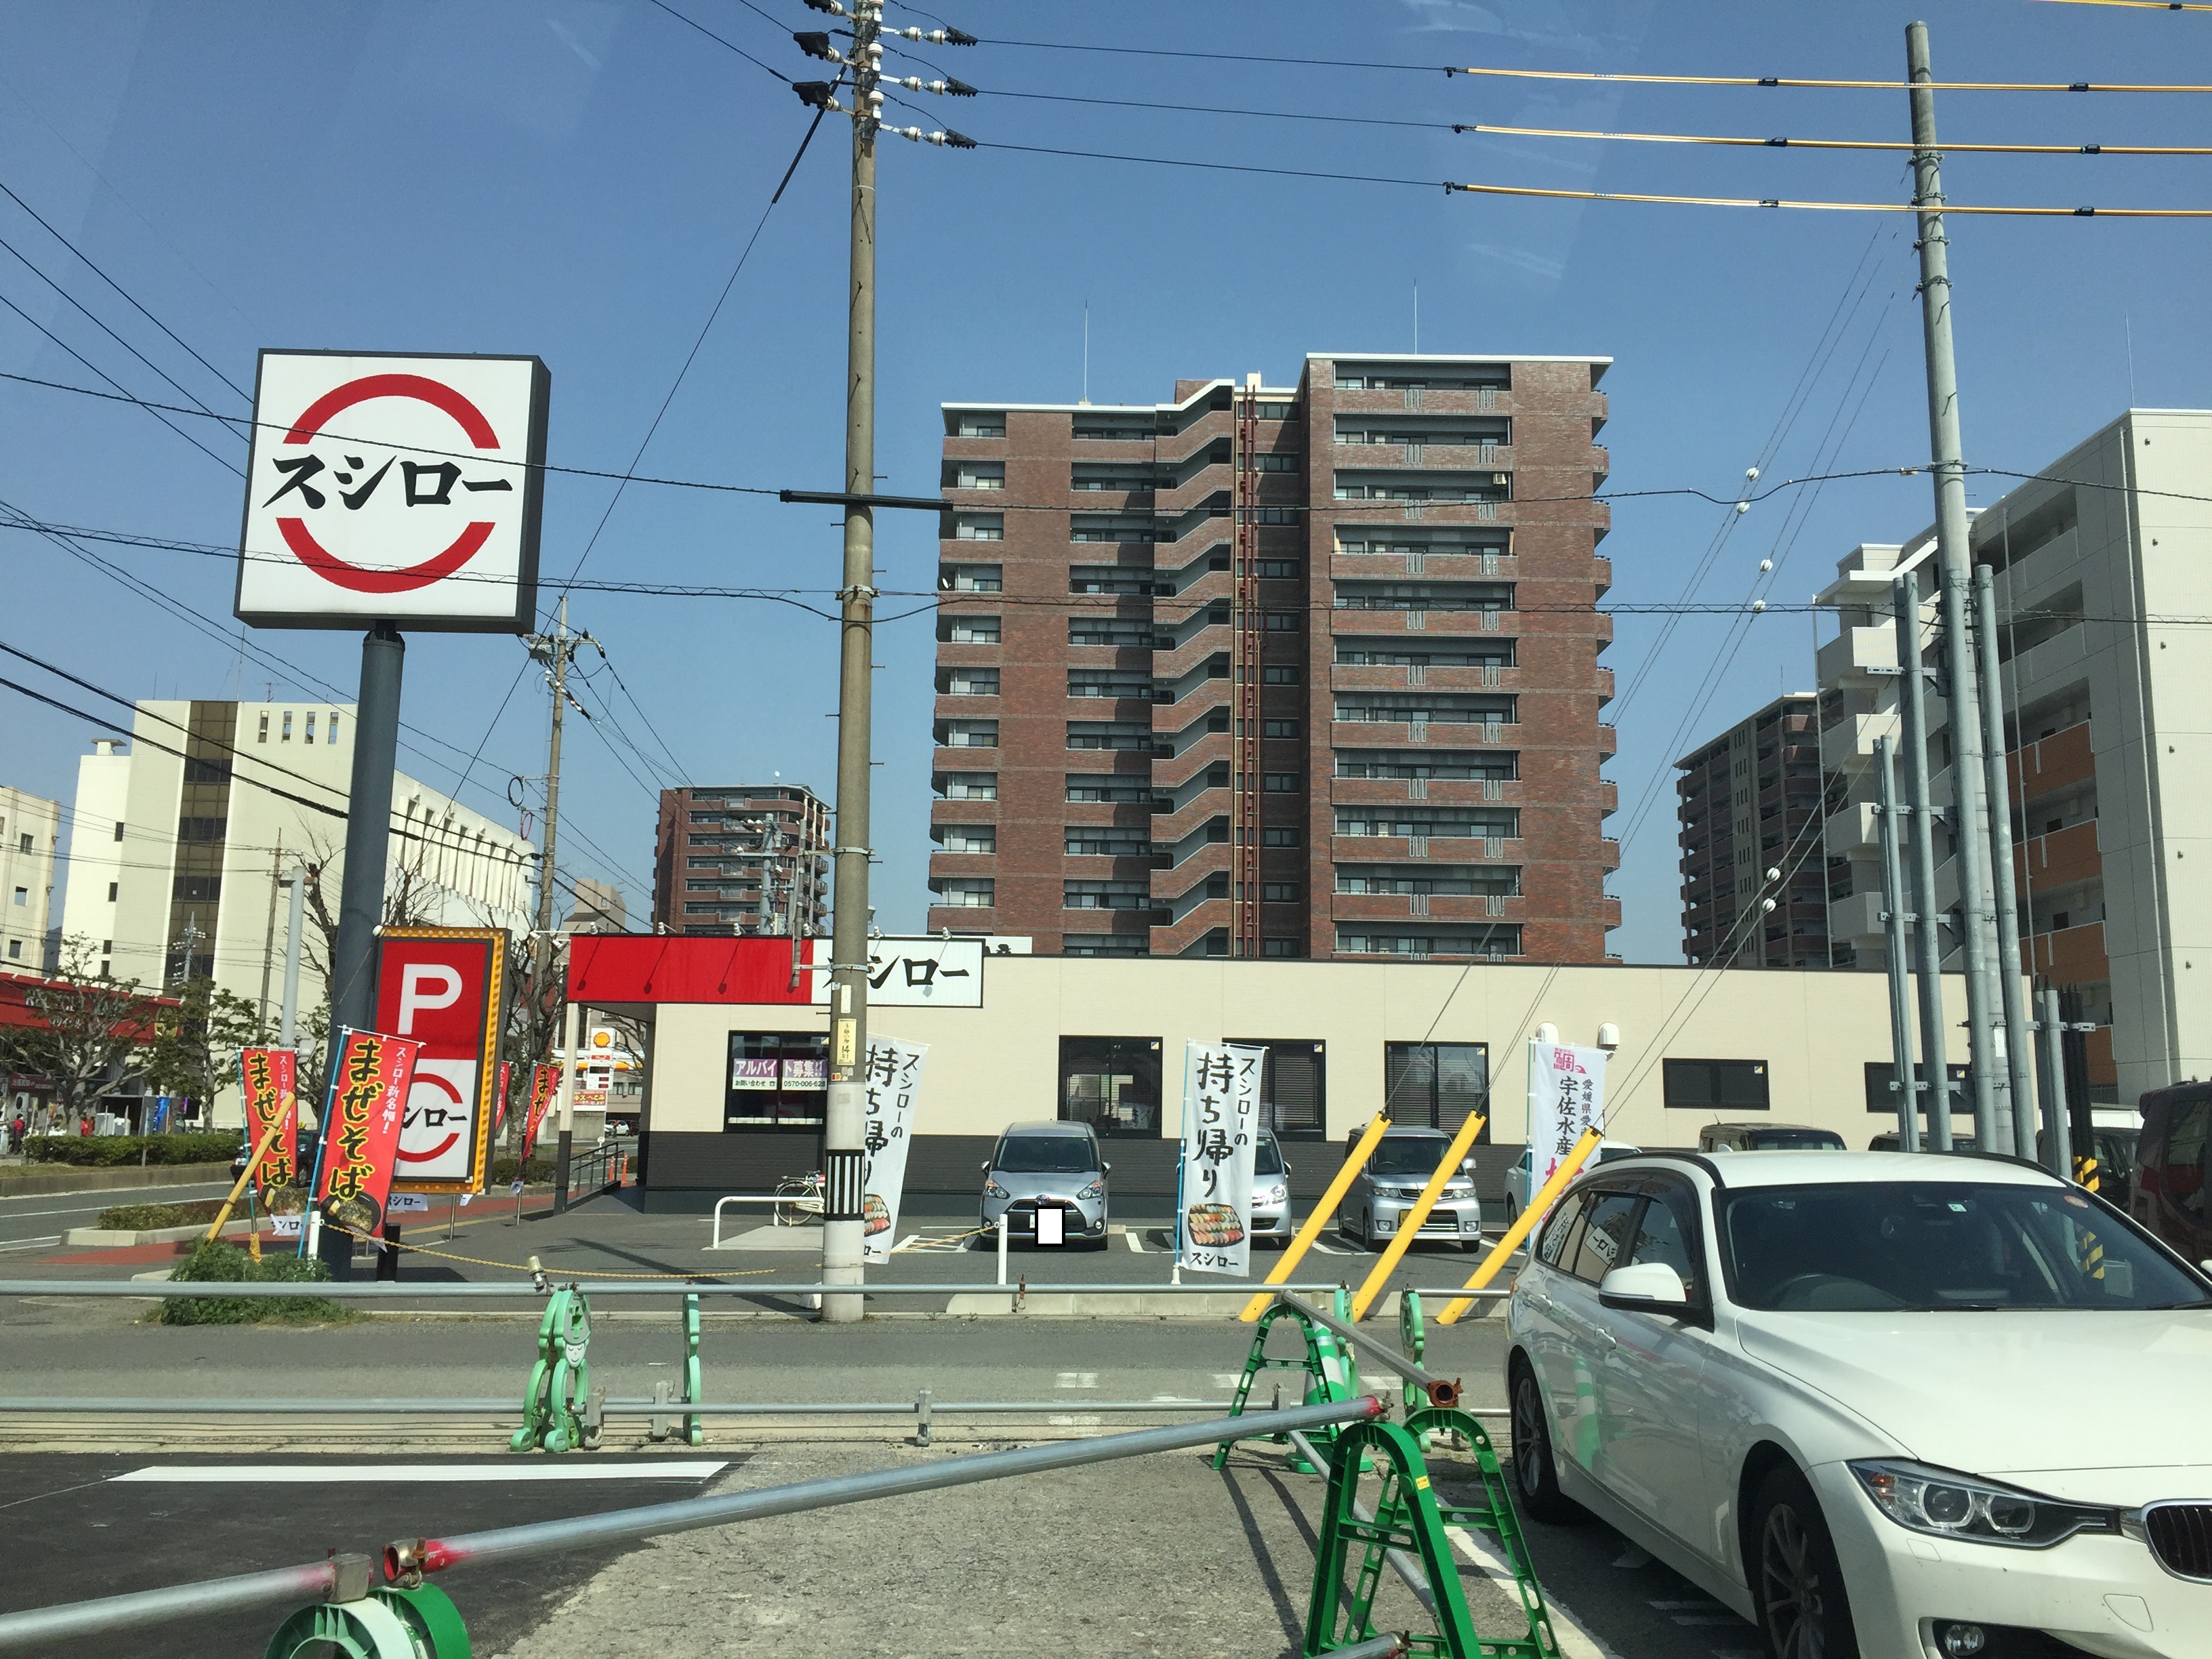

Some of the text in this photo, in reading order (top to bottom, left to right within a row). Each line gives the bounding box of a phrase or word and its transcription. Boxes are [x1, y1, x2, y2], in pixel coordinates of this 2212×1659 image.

[262, 454, 513, 510] スシロー
[397, 963, 463, 1035] P
[823, 955, 970, 989] シロー
[328, 1038, 386, 1201] まぜそば
[402, 1106, 468, 1128] シロー
[890, 1052, 920, 1139] スシローの
[1192, 1052, 1235, 1198] 持ち帰り
[1233, 1057, 1256, 1147] スシローの
[1555, 1076, 1579, 1155] 宇佐水産
[1189, 1251, 1239, 1268] スシロー
